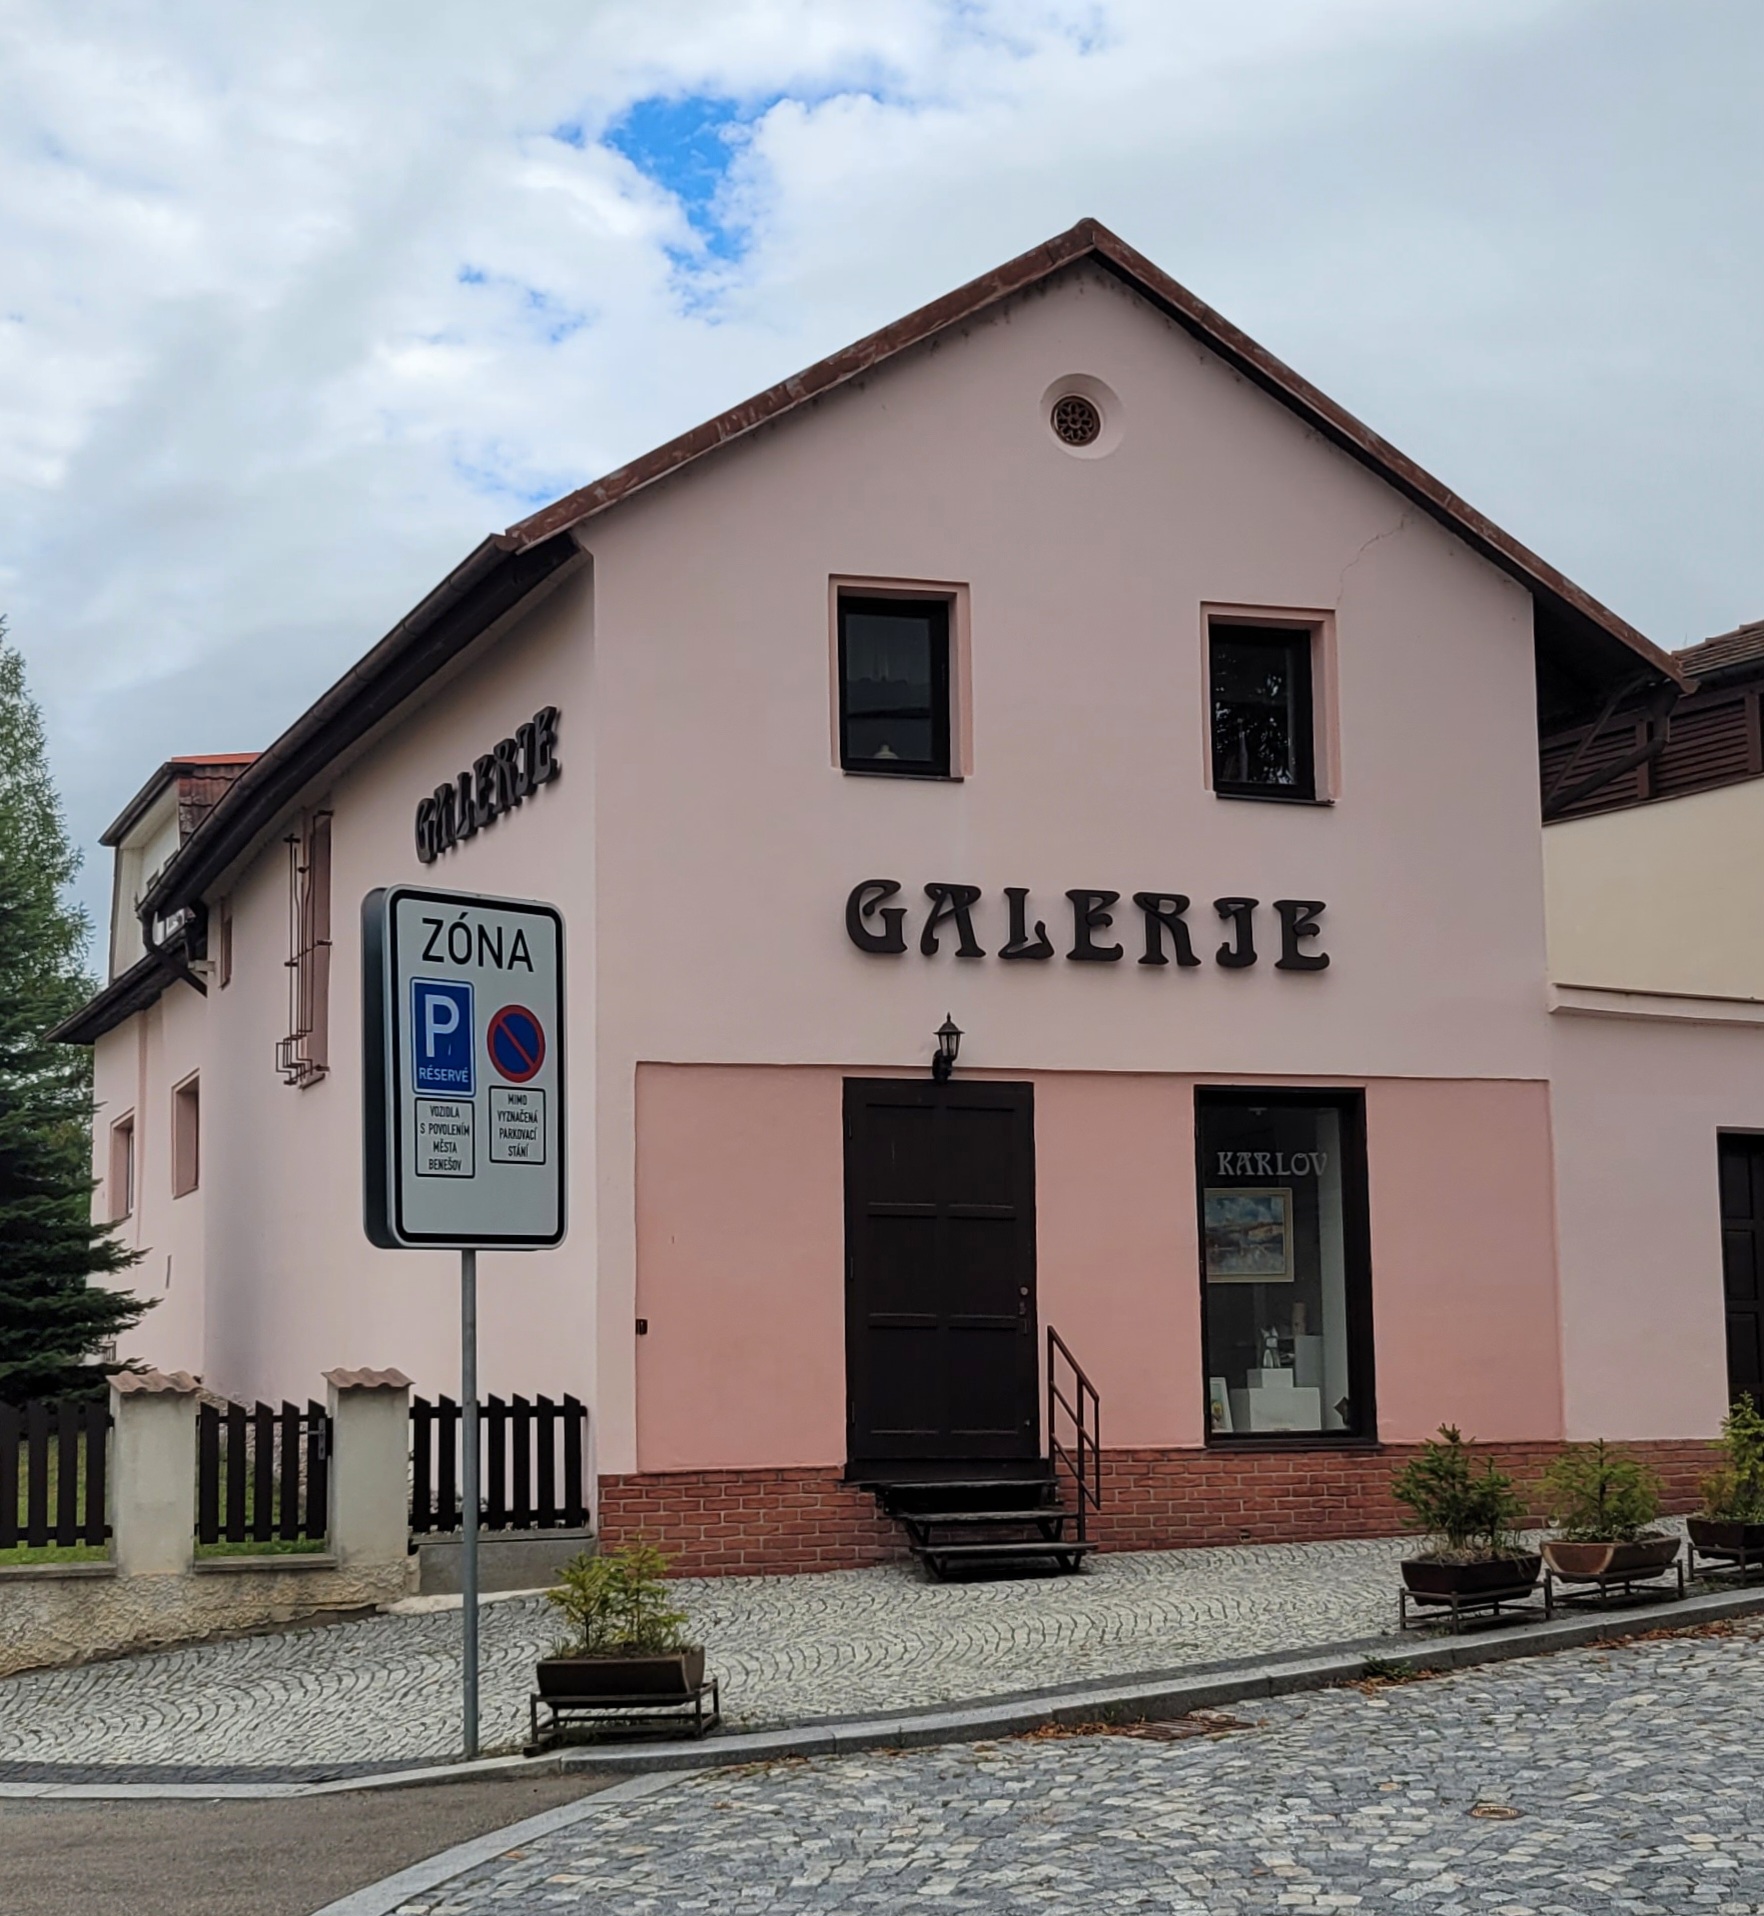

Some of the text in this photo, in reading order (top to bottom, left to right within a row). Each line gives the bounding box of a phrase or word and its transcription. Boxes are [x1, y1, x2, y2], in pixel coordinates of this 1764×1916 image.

[421, 911, 535, 973] ZÓNA
[424, 993, 460, 1058] P
[418, 1064, 469, 1083] RÉSERVÉ
[507, 1093, 528, 1106] MIMO
[429, 1104, 461, 1119] VOZIDLA
[497, 1108, 539, 1124] VYZNAČENÁ
[420, 1122, 470, 1137] S POVOLENÍM
[499, 1126, 538, 1141] PARKOVACÍ
[433, 1138, 458, 1154] MĚSTA
[508, 1143, 530, 1157] STÁNÍ
[428, 1156, 462, 1172] BENEŠOV
[1216, 1151, 1328, 1176] KARLOV
